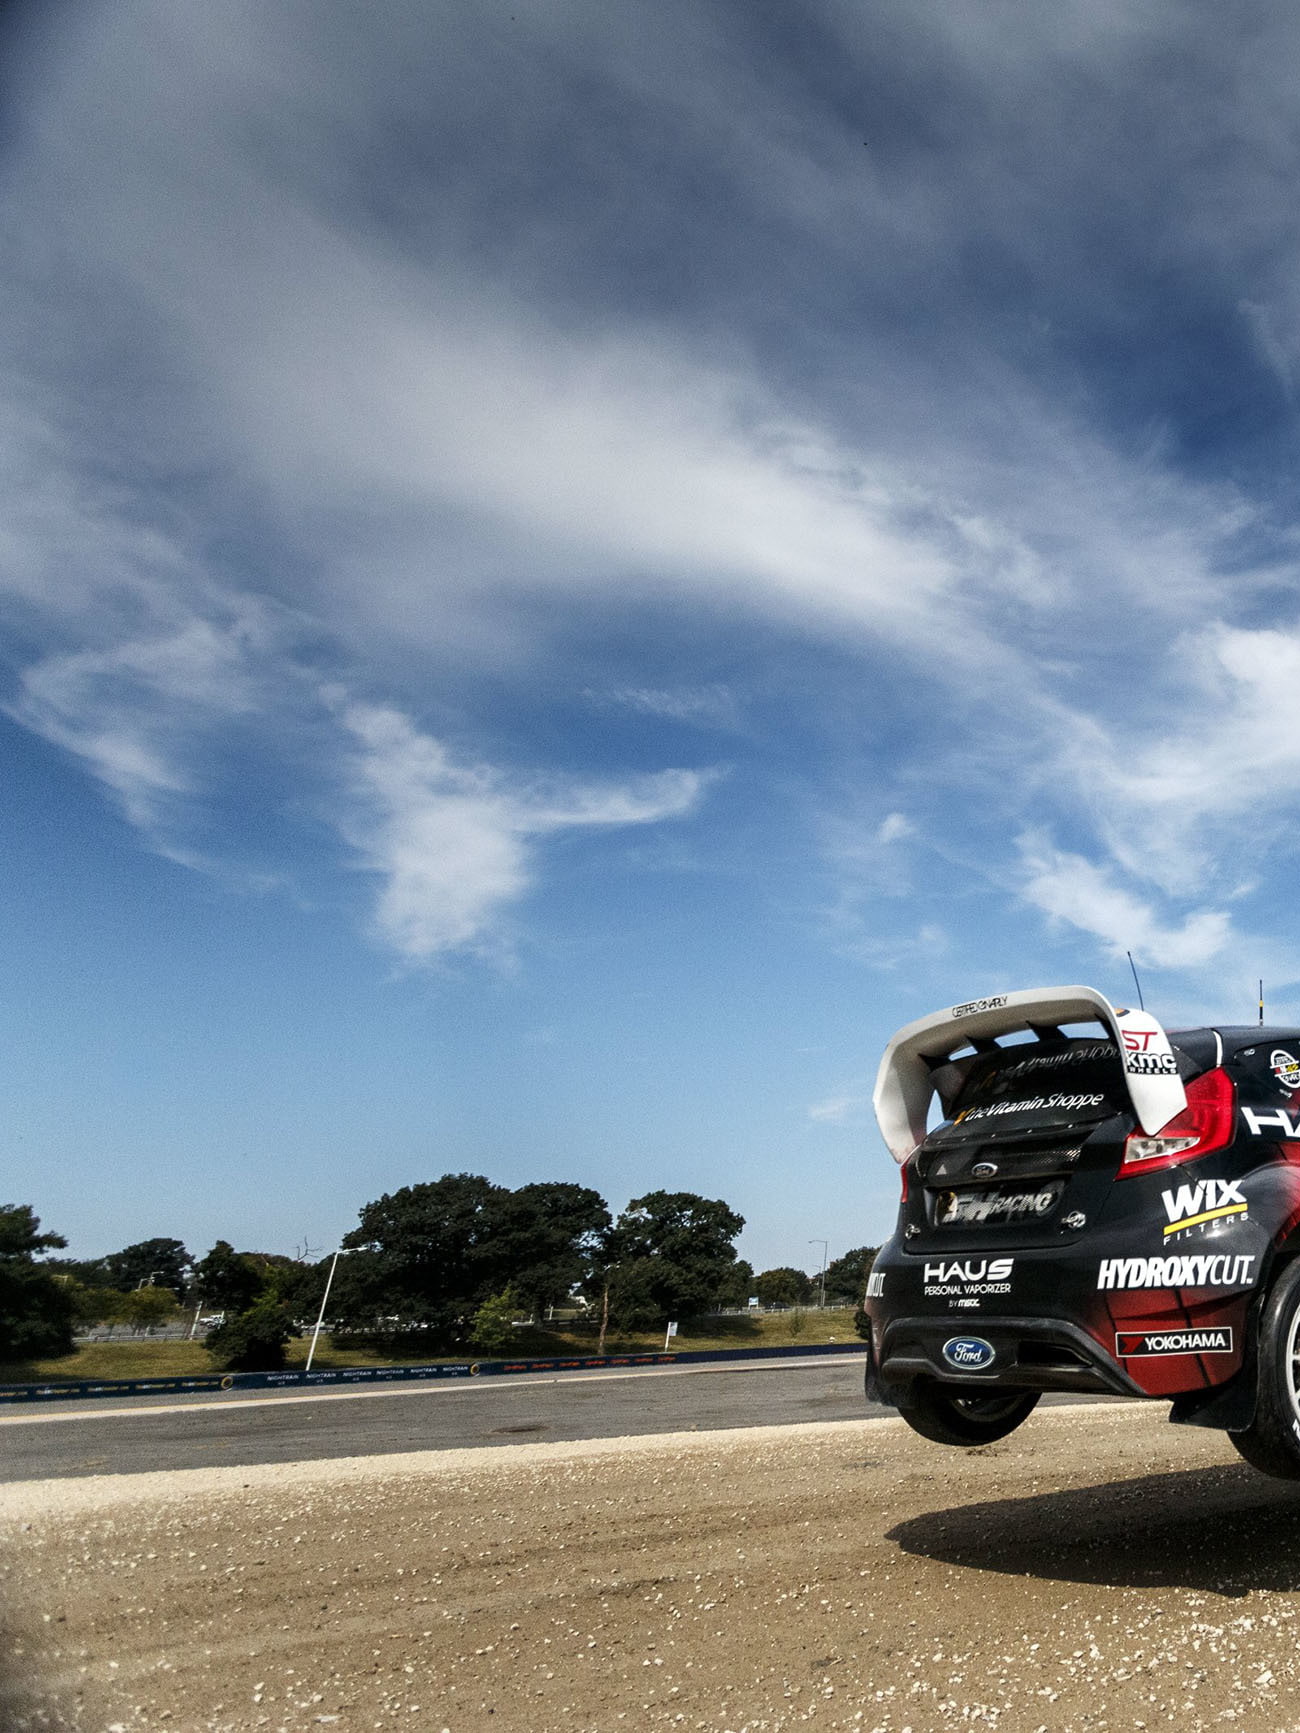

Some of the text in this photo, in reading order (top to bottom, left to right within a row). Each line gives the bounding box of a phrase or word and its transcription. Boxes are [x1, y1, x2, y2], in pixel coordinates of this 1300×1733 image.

[1121, 1029, 1158, 1052] ST
[1042, 1092, 1105, 1111] Shoppe
[1161, 1179, 1247, 1223] WIX
[1163, 1211, 1249, 1246] FILTERS
[923, 1258, 1014, 1283] HAUS
[924, 1283, 1012, 1296] PERSONAL VAPORIZER
[954, 1342, 983, 1362] Ford
[1144, 1332, 1226, 1351] YOKOHAMA
